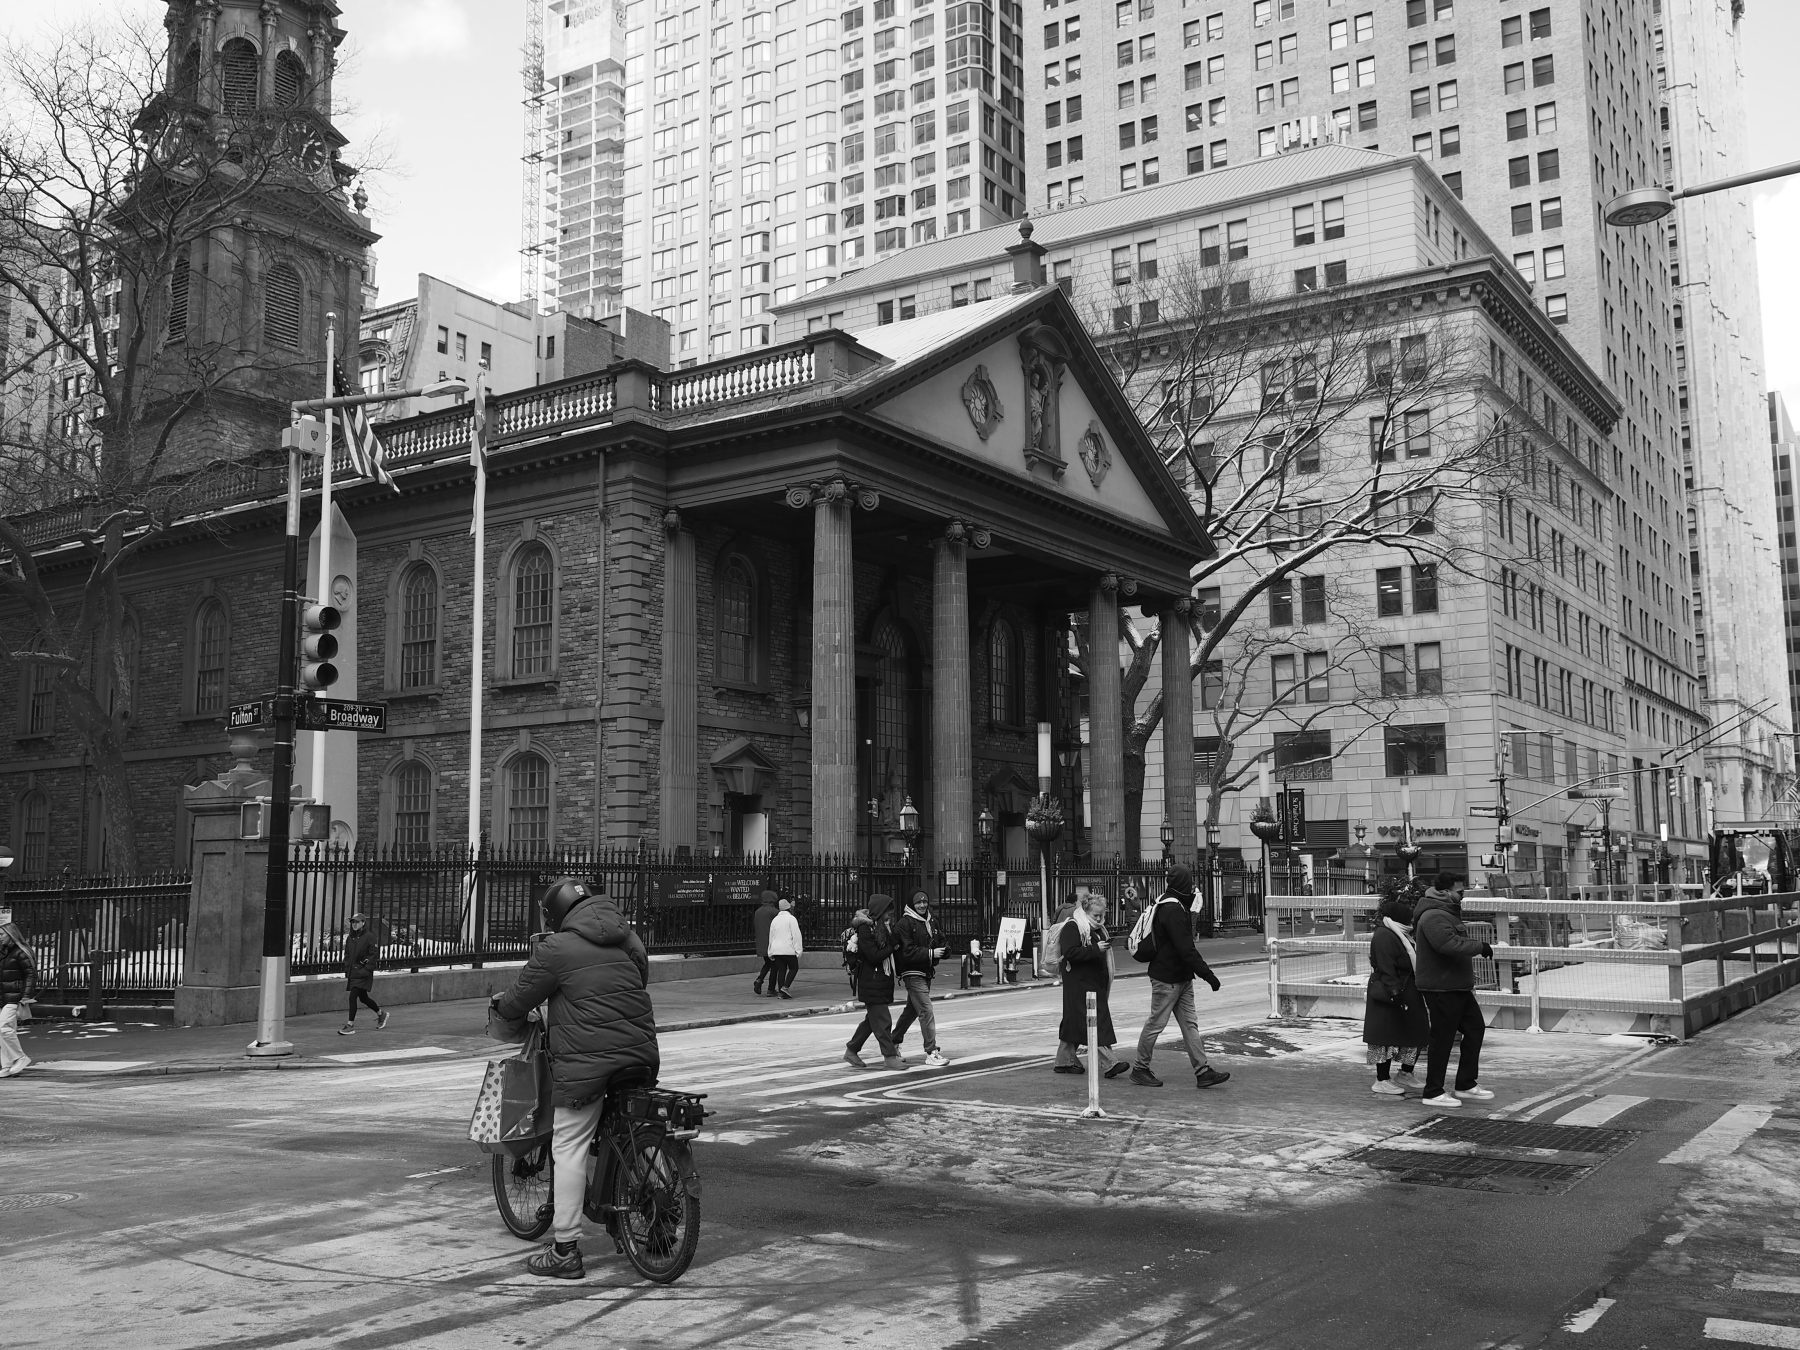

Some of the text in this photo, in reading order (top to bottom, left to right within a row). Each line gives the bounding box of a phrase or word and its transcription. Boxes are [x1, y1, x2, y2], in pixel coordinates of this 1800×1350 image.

[231, 710, 253, 726] Fulton
[253, 707, 259, 716] ST
[330, 709, 380, 727] Broadway
[1414, 826, 1461, 837] pharmacy
